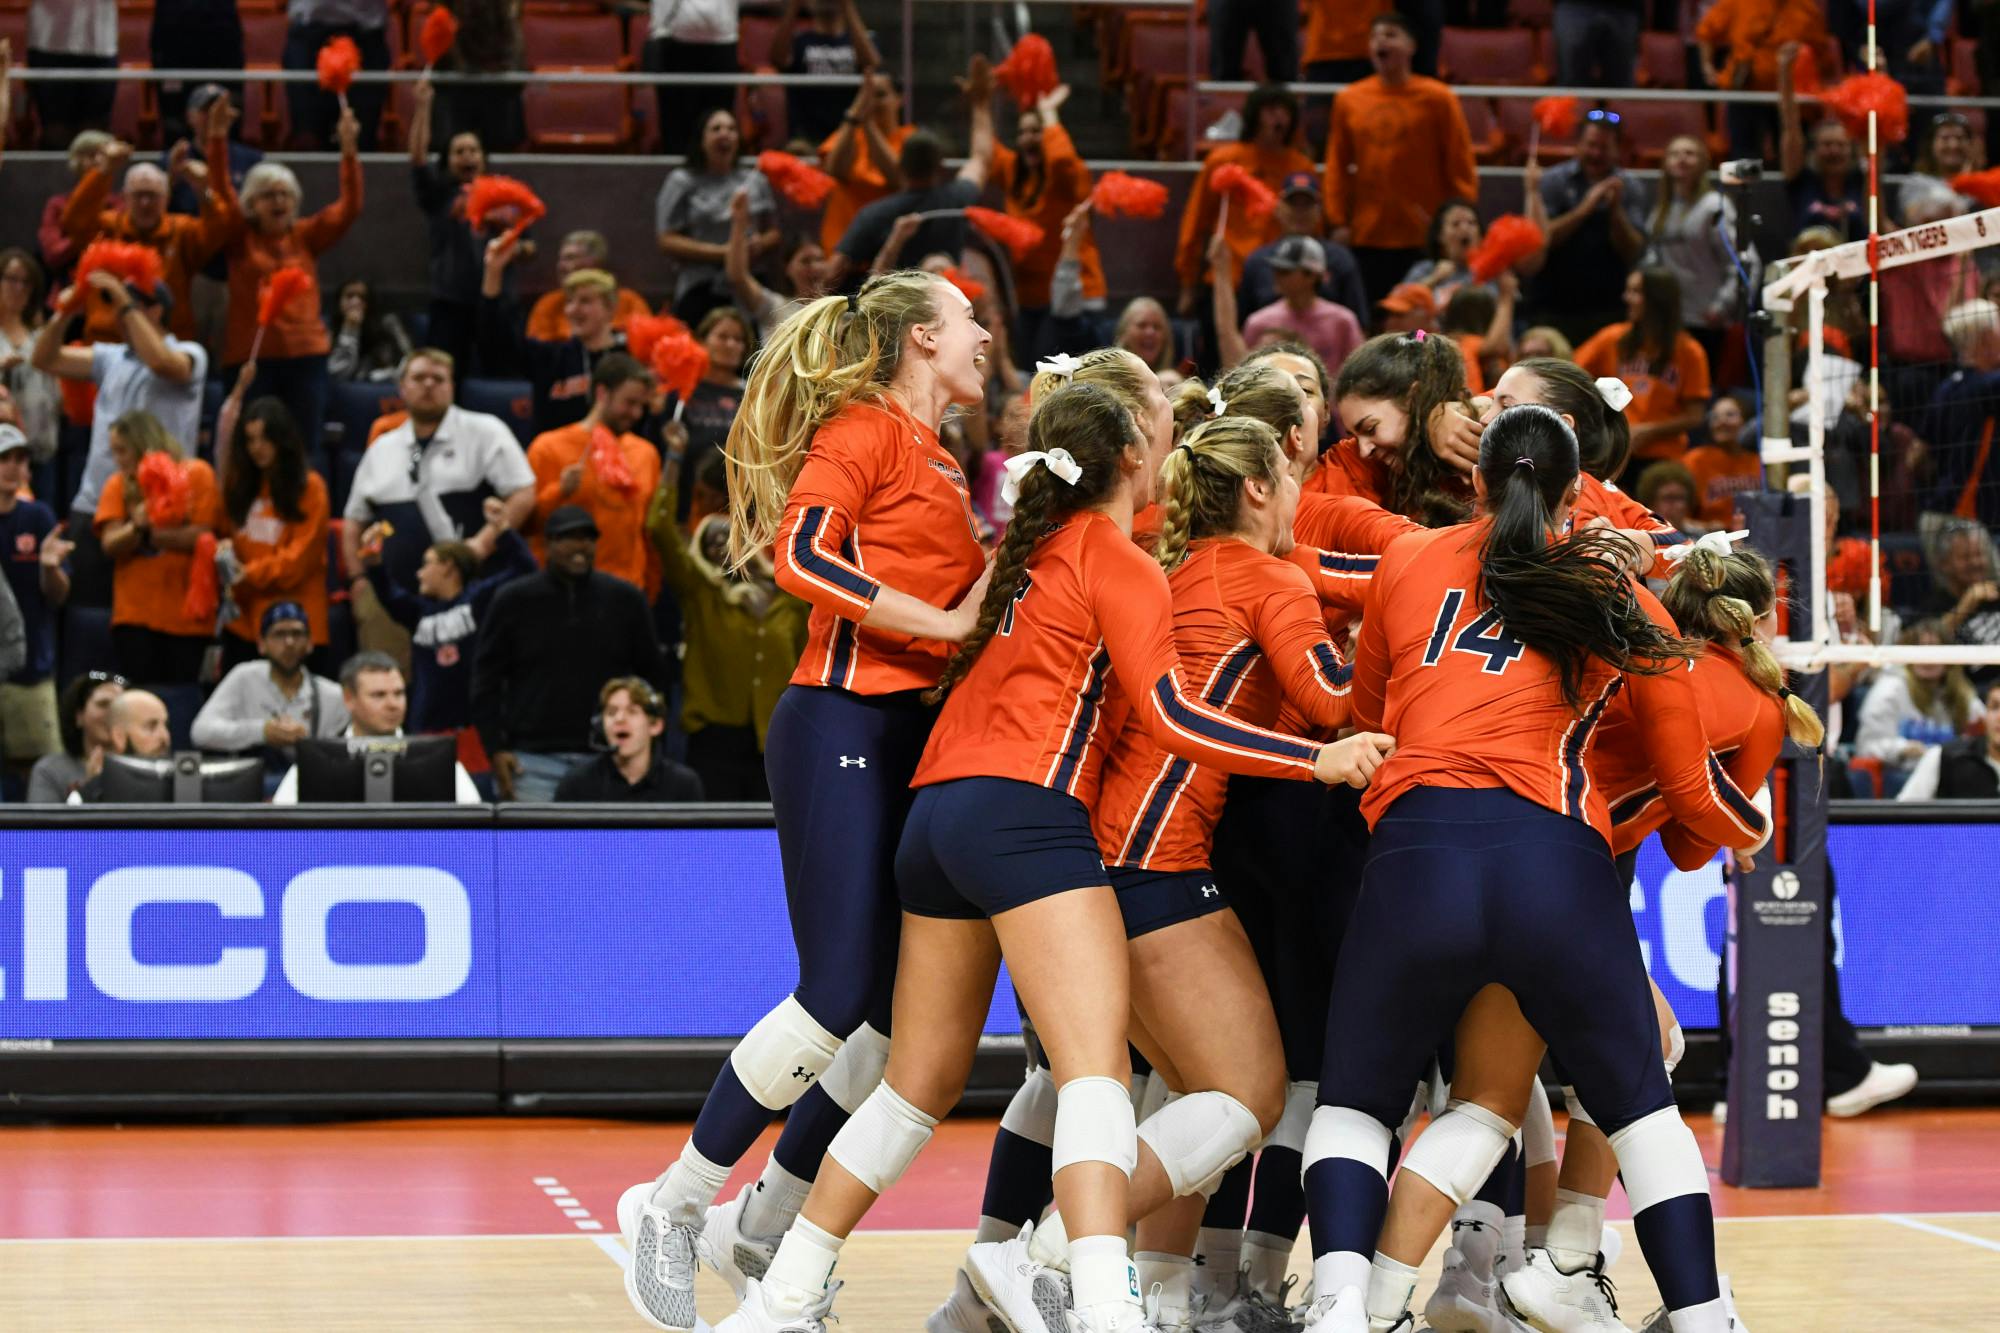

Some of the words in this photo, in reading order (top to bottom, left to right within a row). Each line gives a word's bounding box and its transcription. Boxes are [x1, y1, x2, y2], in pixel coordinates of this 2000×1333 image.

[1907, 224, 1948, 252] TIGERS
[1421, 588, 1526, 675] 14
[0, 865, 472, 1002] ICO
[1767, 992, 1800, 1120] Senoh
